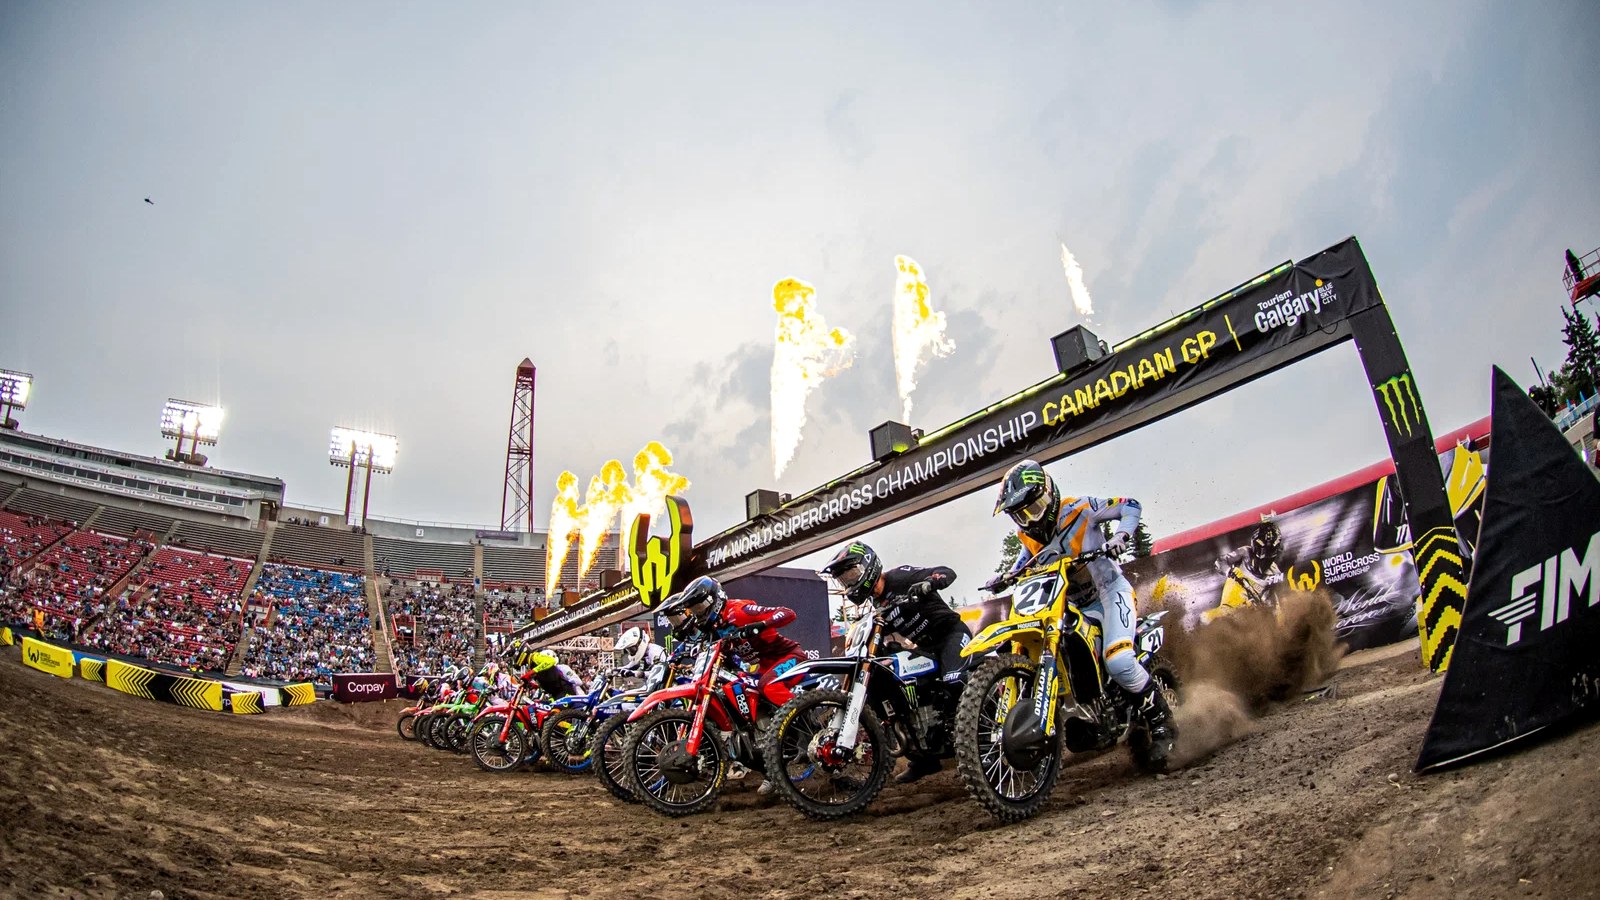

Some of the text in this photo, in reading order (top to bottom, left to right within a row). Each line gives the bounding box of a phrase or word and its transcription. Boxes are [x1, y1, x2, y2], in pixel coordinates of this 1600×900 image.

[1318, 282, 1334, 294] BLUE
[1320, 290, 1333, 299] SKY
[1257, 290, 1293, 311] Tourism
[1322, 294, 1337, 305] CITY
[1254, 288, 1321, 333] Calgary
[706, 330, 1217, 569] FIM WORLD SUPERCROSS CHAMPIONSHIP CANADIAN GP
[1322, 552, 1353, 569] WORLD
[1323, 553, 1380, 578] SUPERCROSS
[1325, 565, 1371, 585] CHAMPIONSHIP
[1016, 579, 1056, 610] 21
[1488, 531, 1600, 646] FIM
[1147, 629, 1162, 653] 21
[347, 682, 385, 694] Corpay
